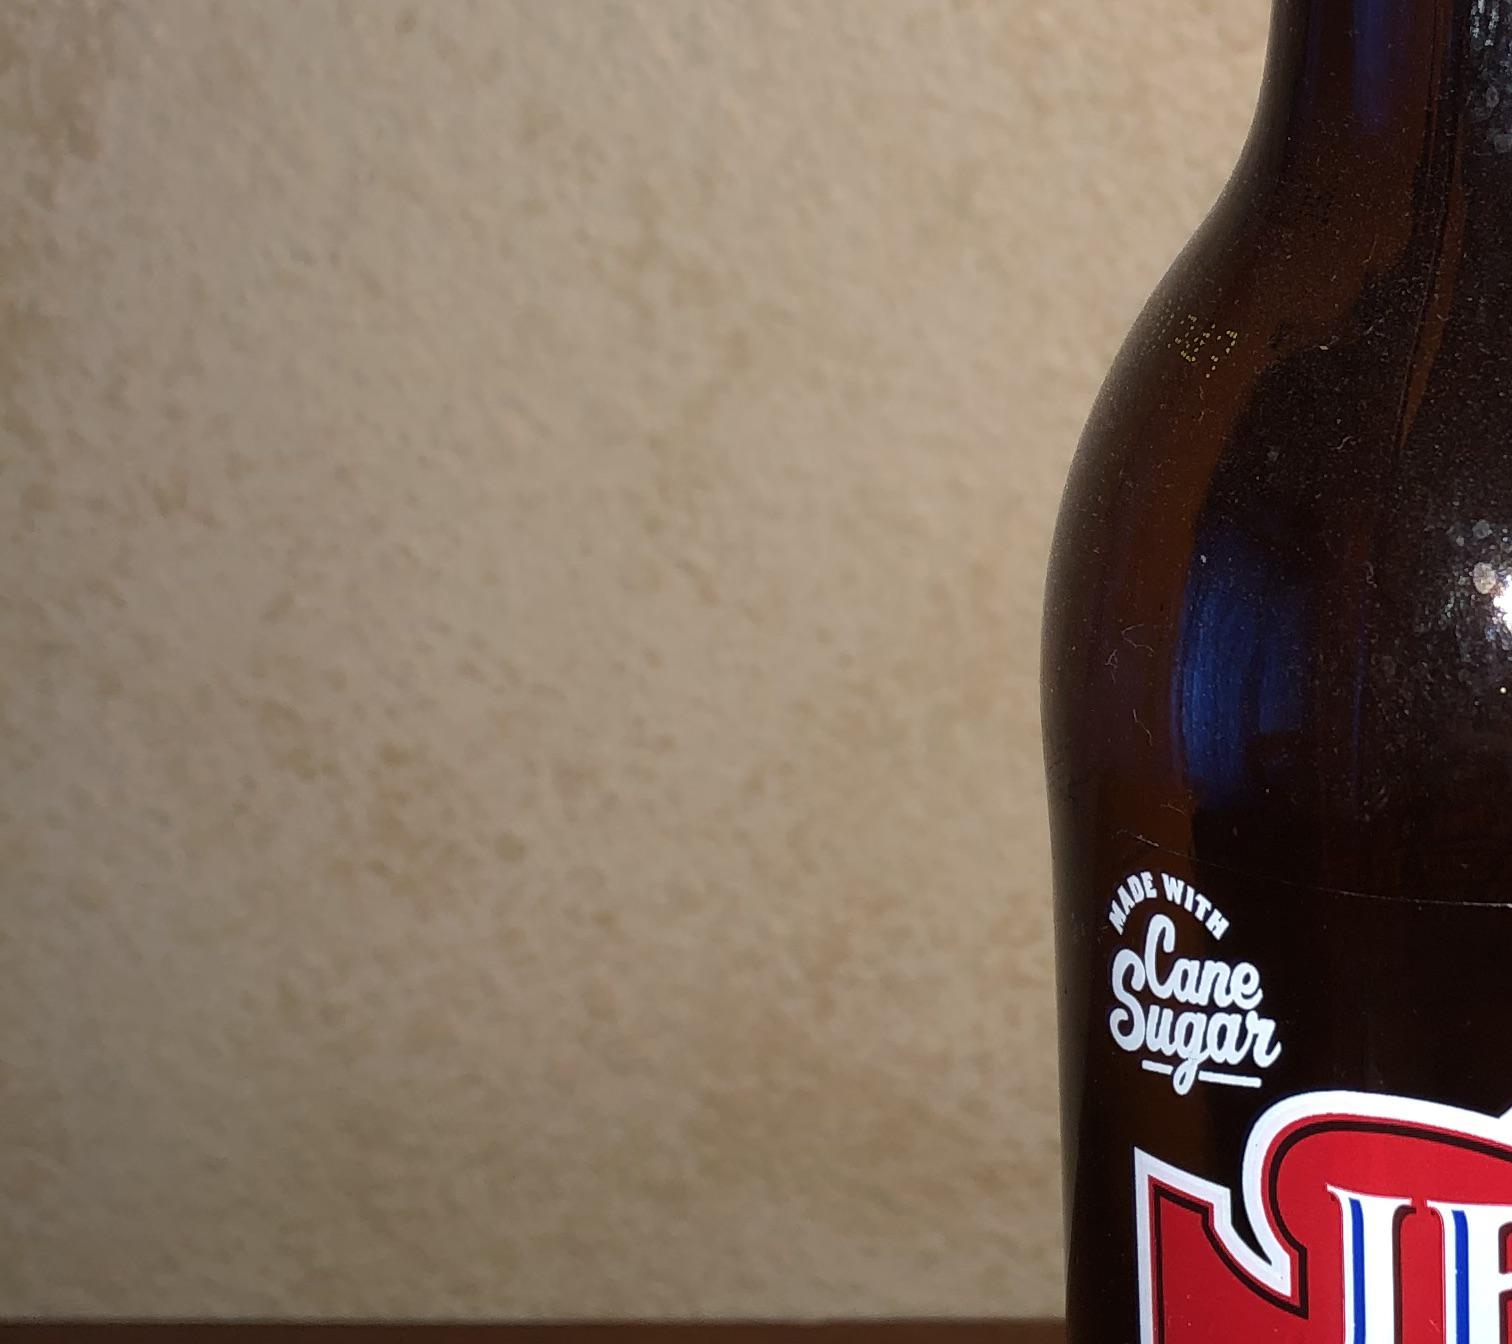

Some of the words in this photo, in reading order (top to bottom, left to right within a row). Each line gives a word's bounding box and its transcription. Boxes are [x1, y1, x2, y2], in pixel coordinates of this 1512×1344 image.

[1108, 871, 1157, 936] MADE
[1161, 872, 1230, 940] WITH
[1144, 913, 1263, 1010] Cane
[1109, 948, 1282, 1096] Sugar
